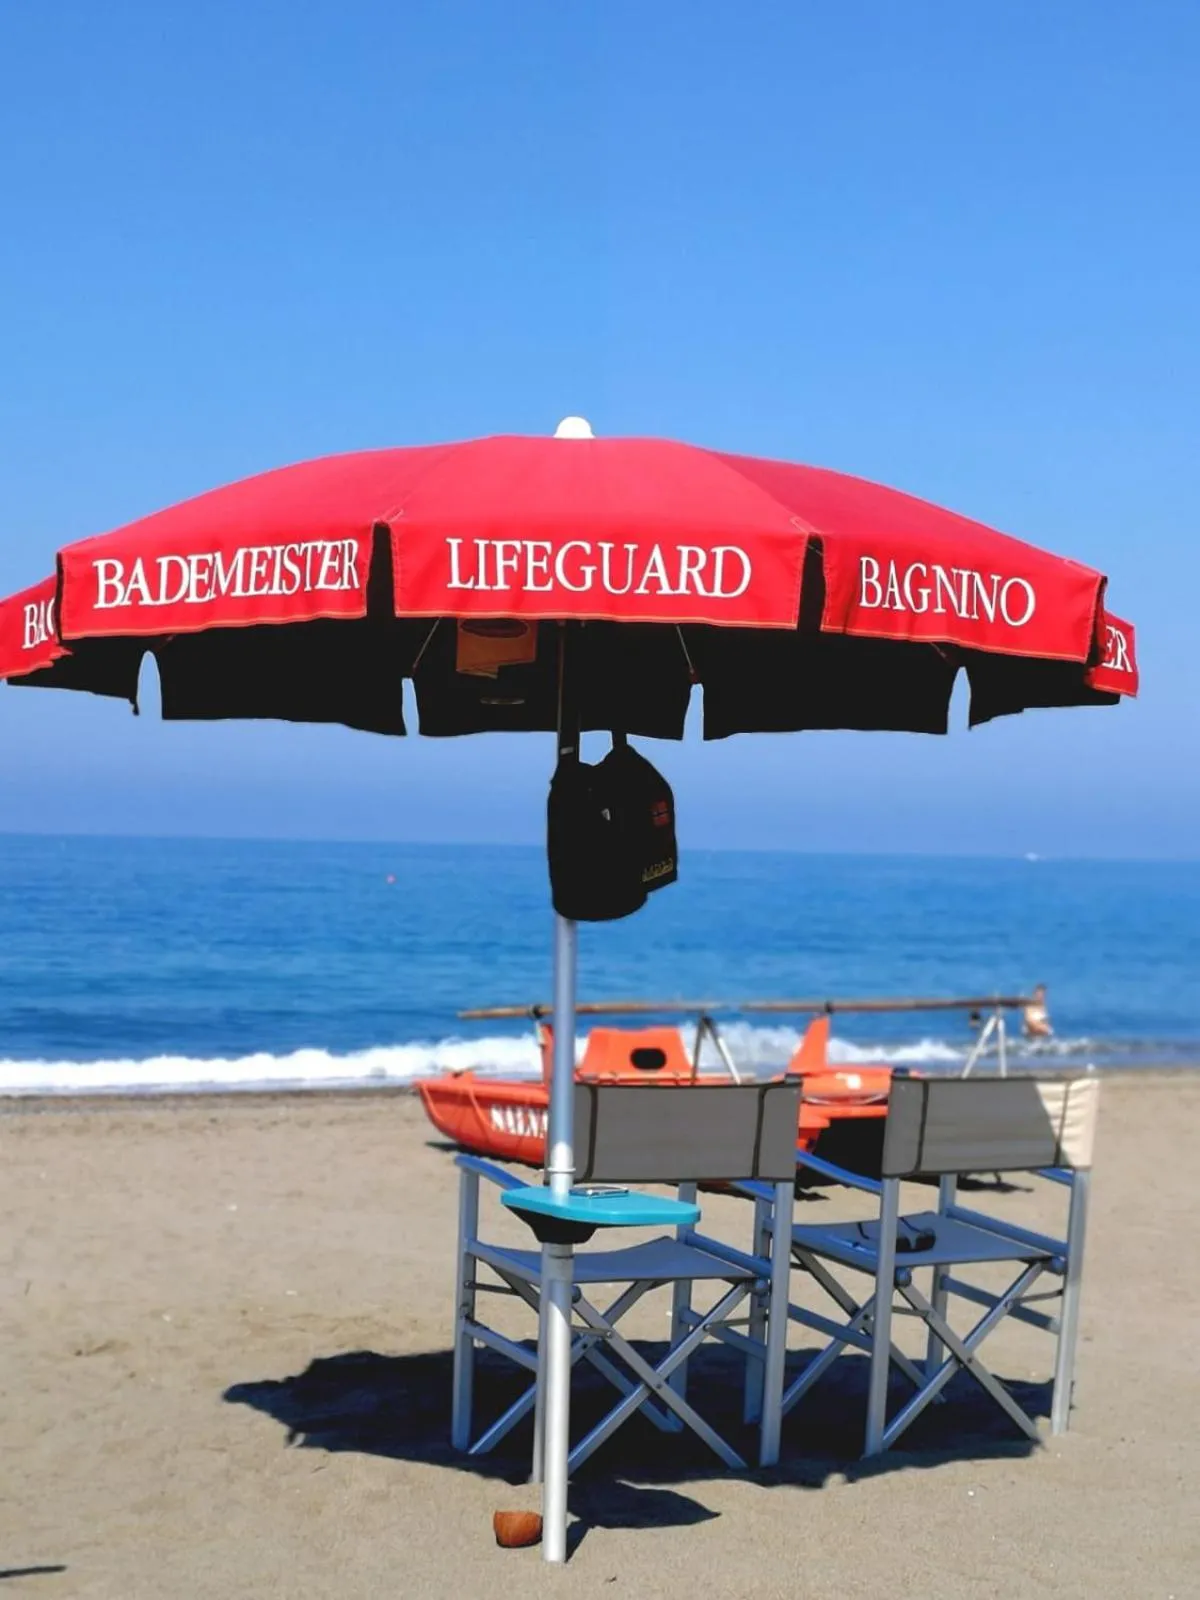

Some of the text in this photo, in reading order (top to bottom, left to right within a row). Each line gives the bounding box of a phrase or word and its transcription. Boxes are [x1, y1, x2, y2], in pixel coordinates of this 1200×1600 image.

[93, 537, 360, 610] BADEMEISTER
[445, 537, 752, 598] LIFEGUARD
[859, 556, 1037, 627] BAGNINO
